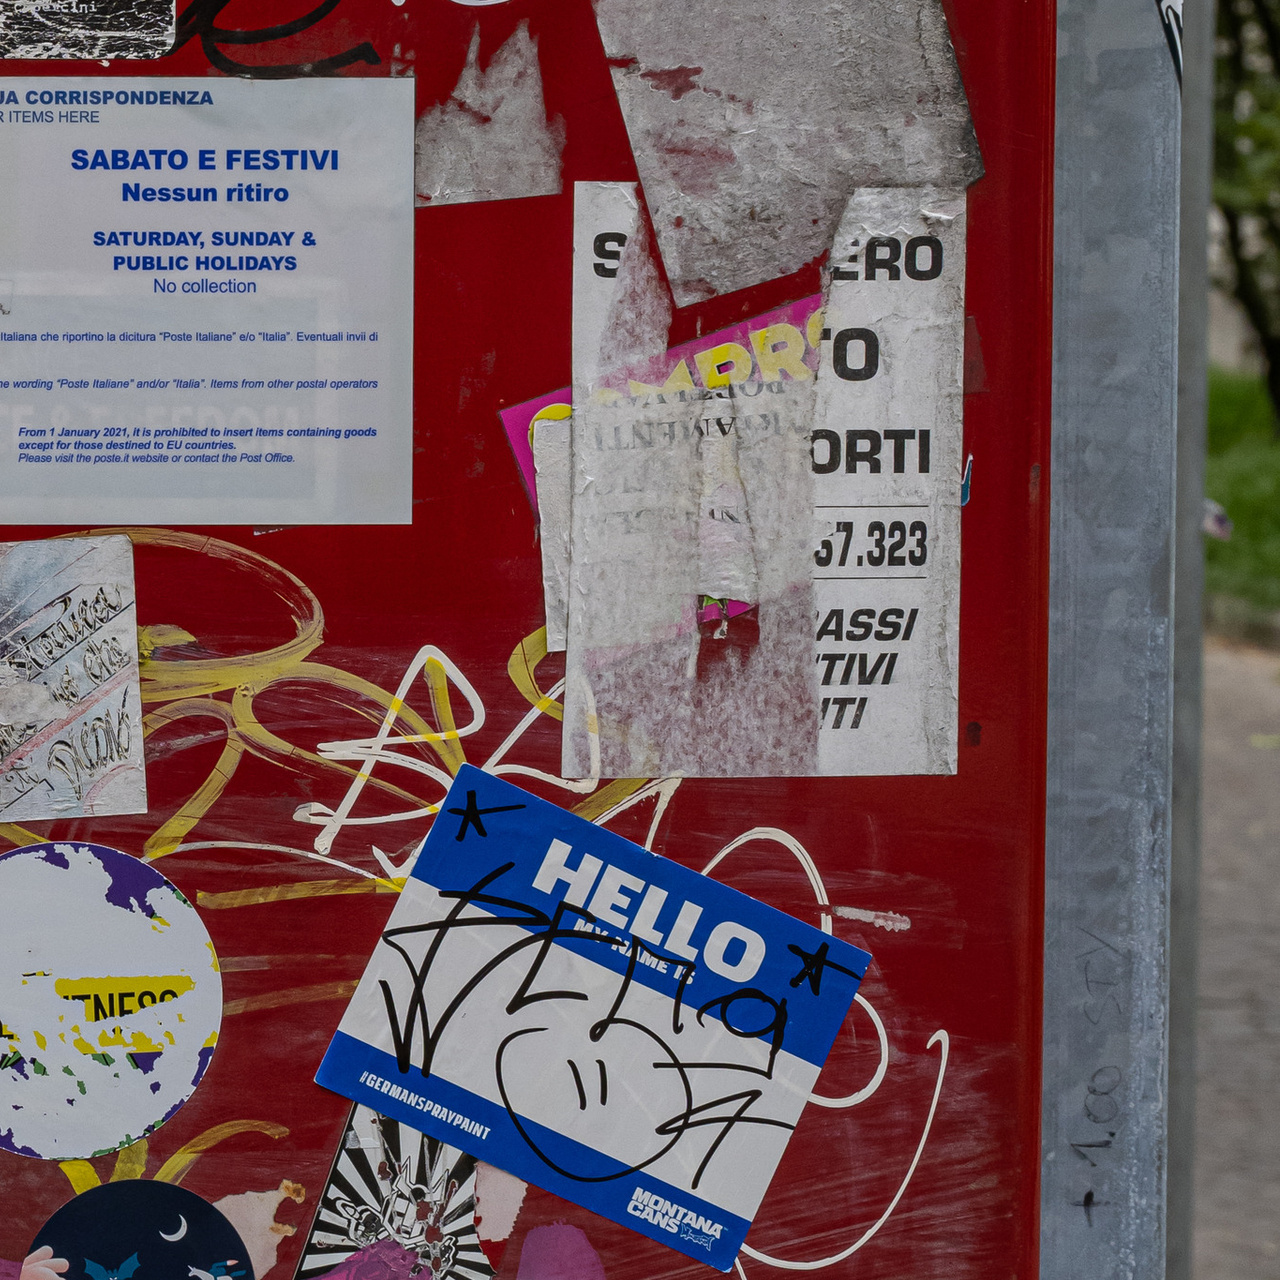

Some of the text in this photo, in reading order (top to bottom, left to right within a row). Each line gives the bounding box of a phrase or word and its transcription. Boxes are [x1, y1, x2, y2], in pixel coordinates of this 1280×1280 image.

[26, 91, 213, 105] CORRISPONDENZA
[9, 111, 54, 123] ITEMS
[59, 111, 99, 123] HERE
[71, 149, 338, 170] SABATO E FESTIVI
[122, 183, 289, 202] Nessun ritiro
[93, 231, 316, 249] SATURDAY, SUNDAY &
[114, 256, 297, 270] PUBLIC HOLIDAYS
[154, 279, 256, 293] No collection
[532, 838, 766, 984] HELLO
[611, 936, 671, 974] NAME
[359, 1070, 491, 1140] #GERMANSPRAYPAINT
[627, 1199, 680, 1244] CANS
[632, 1187, 723, 1239] MONTANA
